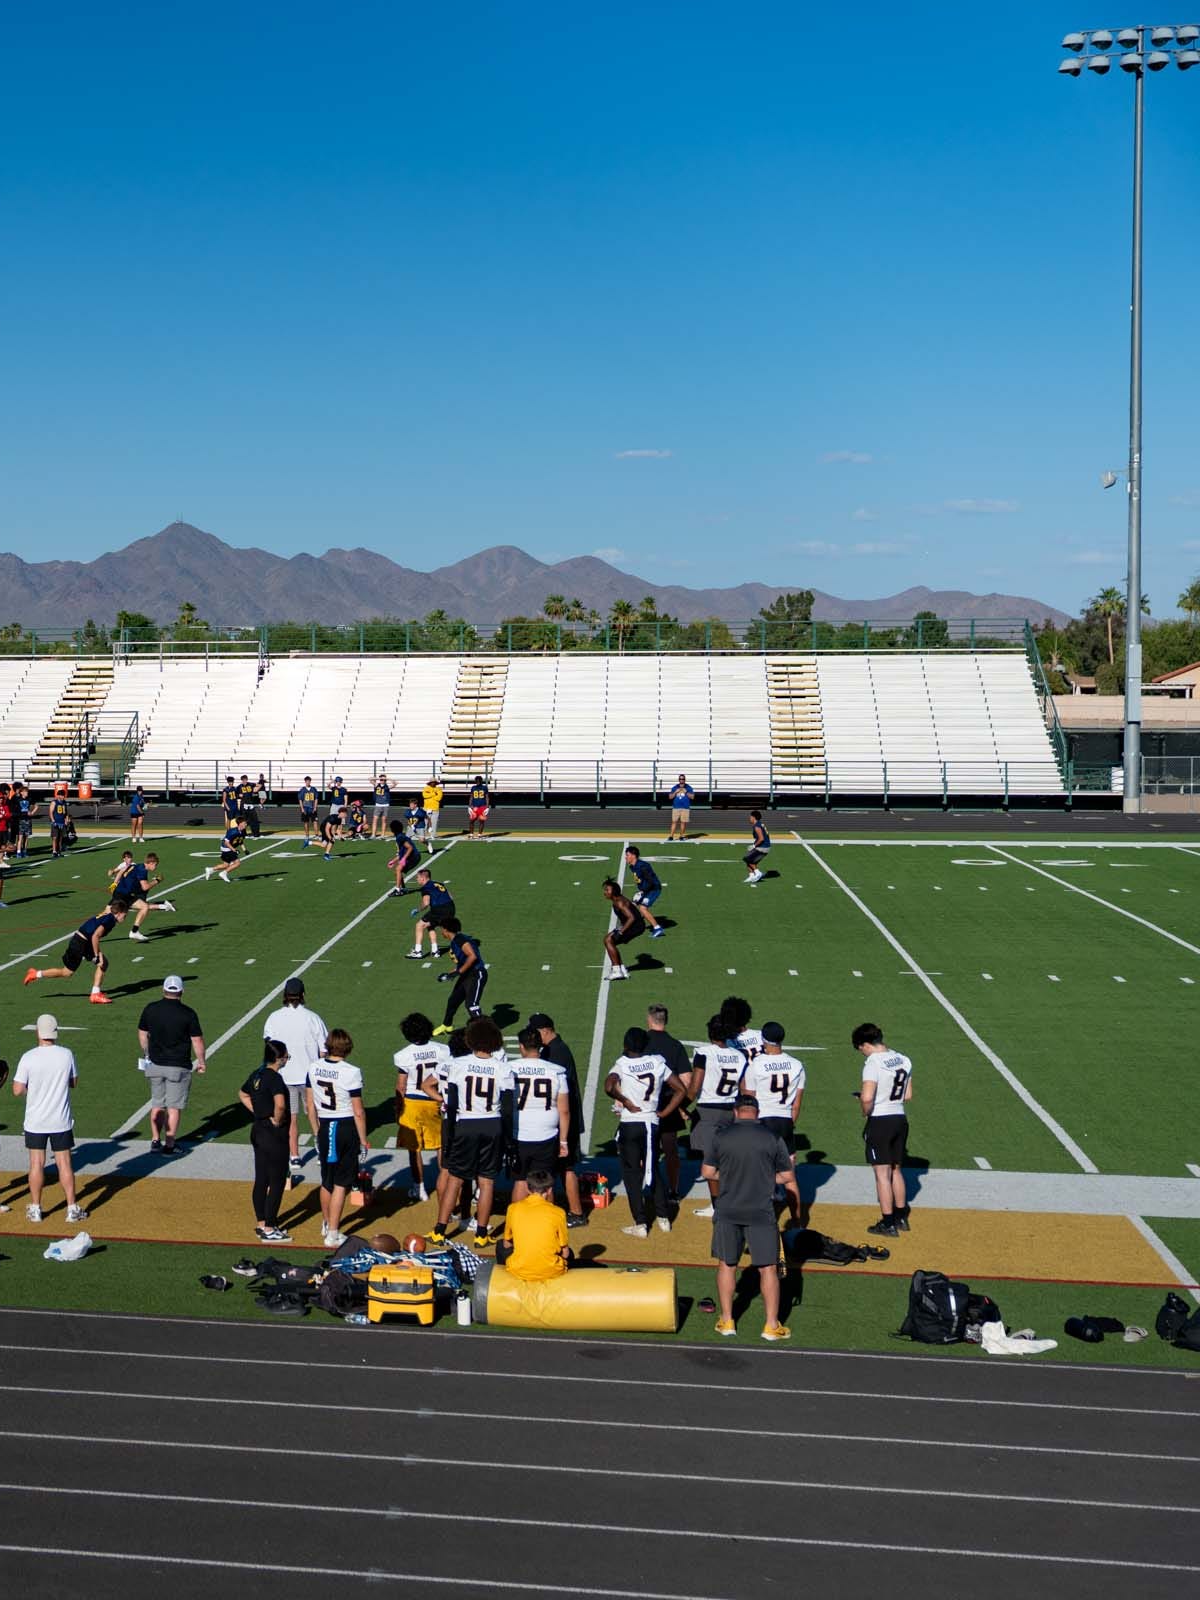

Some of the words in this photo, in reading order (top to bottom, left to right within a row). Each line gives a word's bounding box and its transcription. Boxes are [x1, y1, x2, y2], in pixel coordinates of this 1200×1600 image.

[473, 790, 485, 799] 82
[413, 1050, 437, 1062] SAGUARO
[717, 1053, 739, 1064] SAGUARO
[467, 1064, 495, 1076] SAGUARO
[518, 1066, 545, 1075] SAGUARO
[628, 1062, 655, 1073] SAGUARO
[764, 1062, 792, 1073] SAGUARO
[315, 1068, 340, 1080] SAGUARO
[637, 1072, 656, 1102] 7
[716, 1068, 738, 1097] 6
[889, 1067, 908, 1101] 8
[316, 1079, 337, 1111] 3
[464, 1075, 495, 1112] 14
[517, 1077, 552, 1111] 79
[770, 1073, 789, 1105] 4
